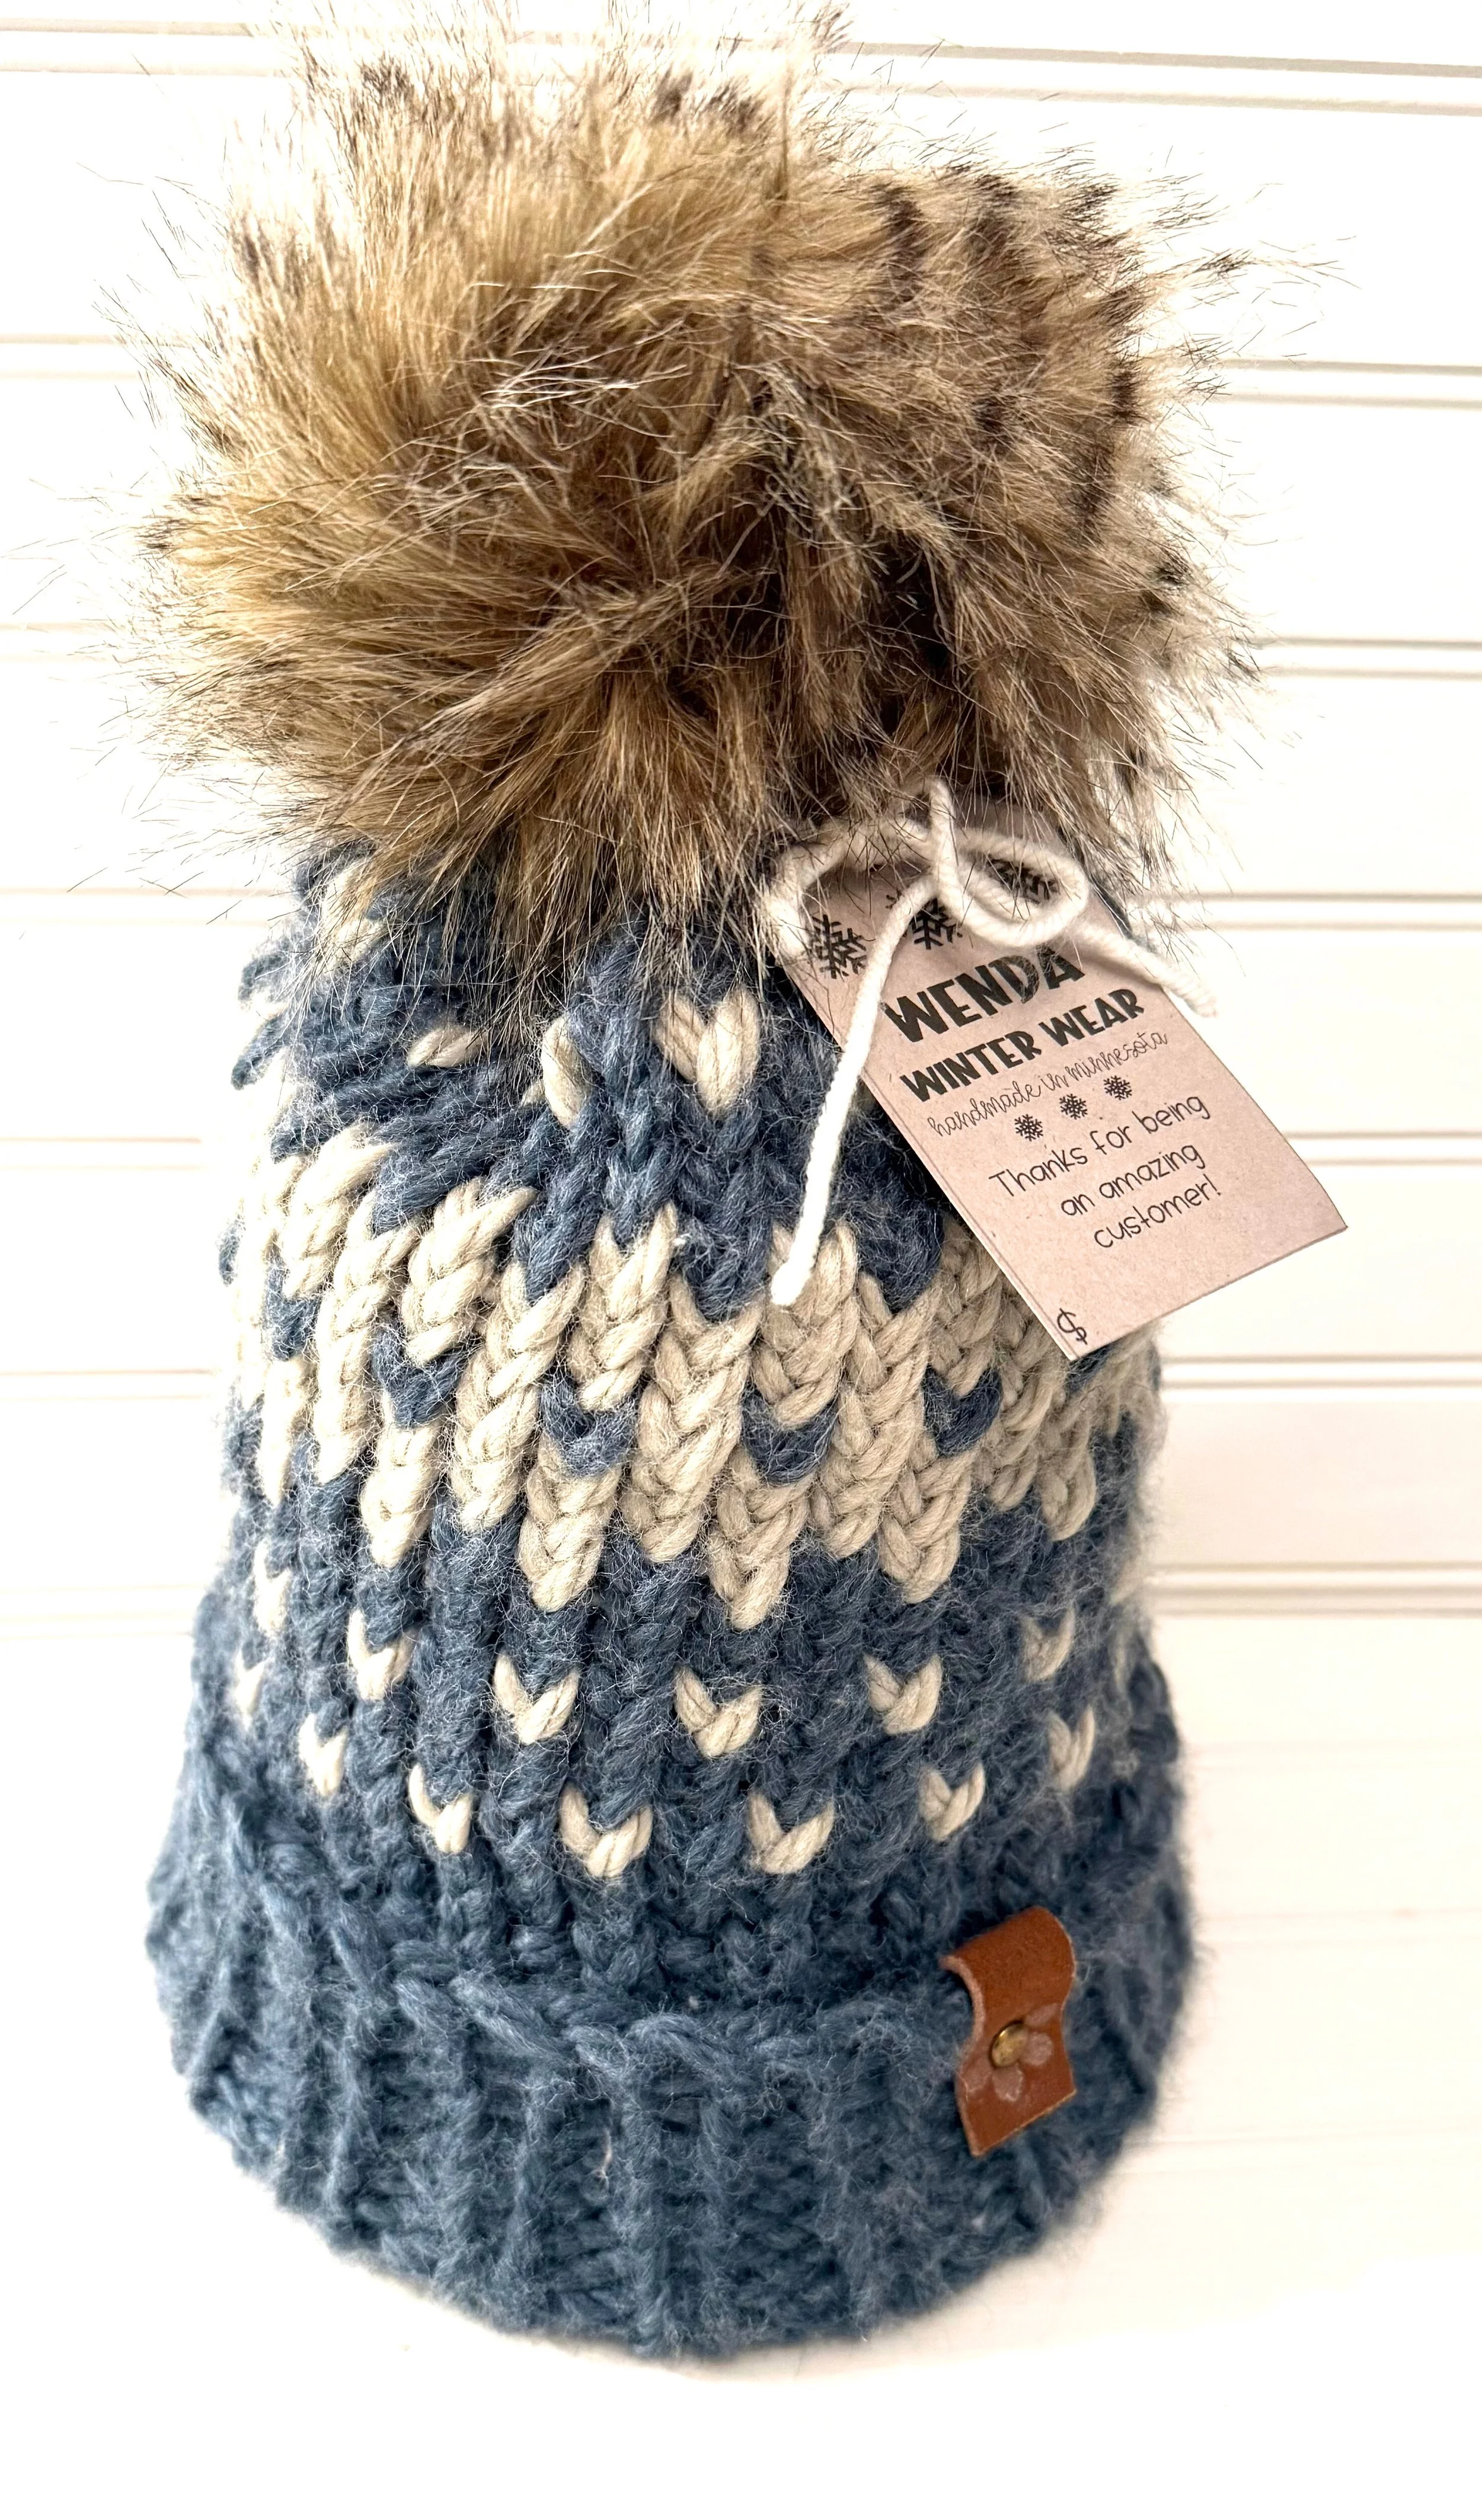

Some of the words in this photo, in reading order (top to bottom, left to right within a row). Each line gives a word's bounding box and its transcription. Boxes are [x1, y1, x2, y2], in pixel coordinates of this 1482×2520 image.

[883, 945, 1085, 1043] WENDA
[899, 1030, 1042, 1102] WINTER
[1038, 988, 1145, 1047] WEAR
[927, 1080, 1042, 1137] handmade
[1039, 1073, 1069, 1092] in
[1065, 1031, 1168, 1082] minnesota
[988, 1147, 1088, 1197] Thanks
[1089, 1125, 1133, 1156] for
[1132, 1096, 1211, 1134] being
[1061, 1193, 1096, 1216] an
[1098, 1144, 1206, 1200] amazing
[1093, 1173, 1222, 1249] customer!
[1056, 1307, 1088, 1346] $
